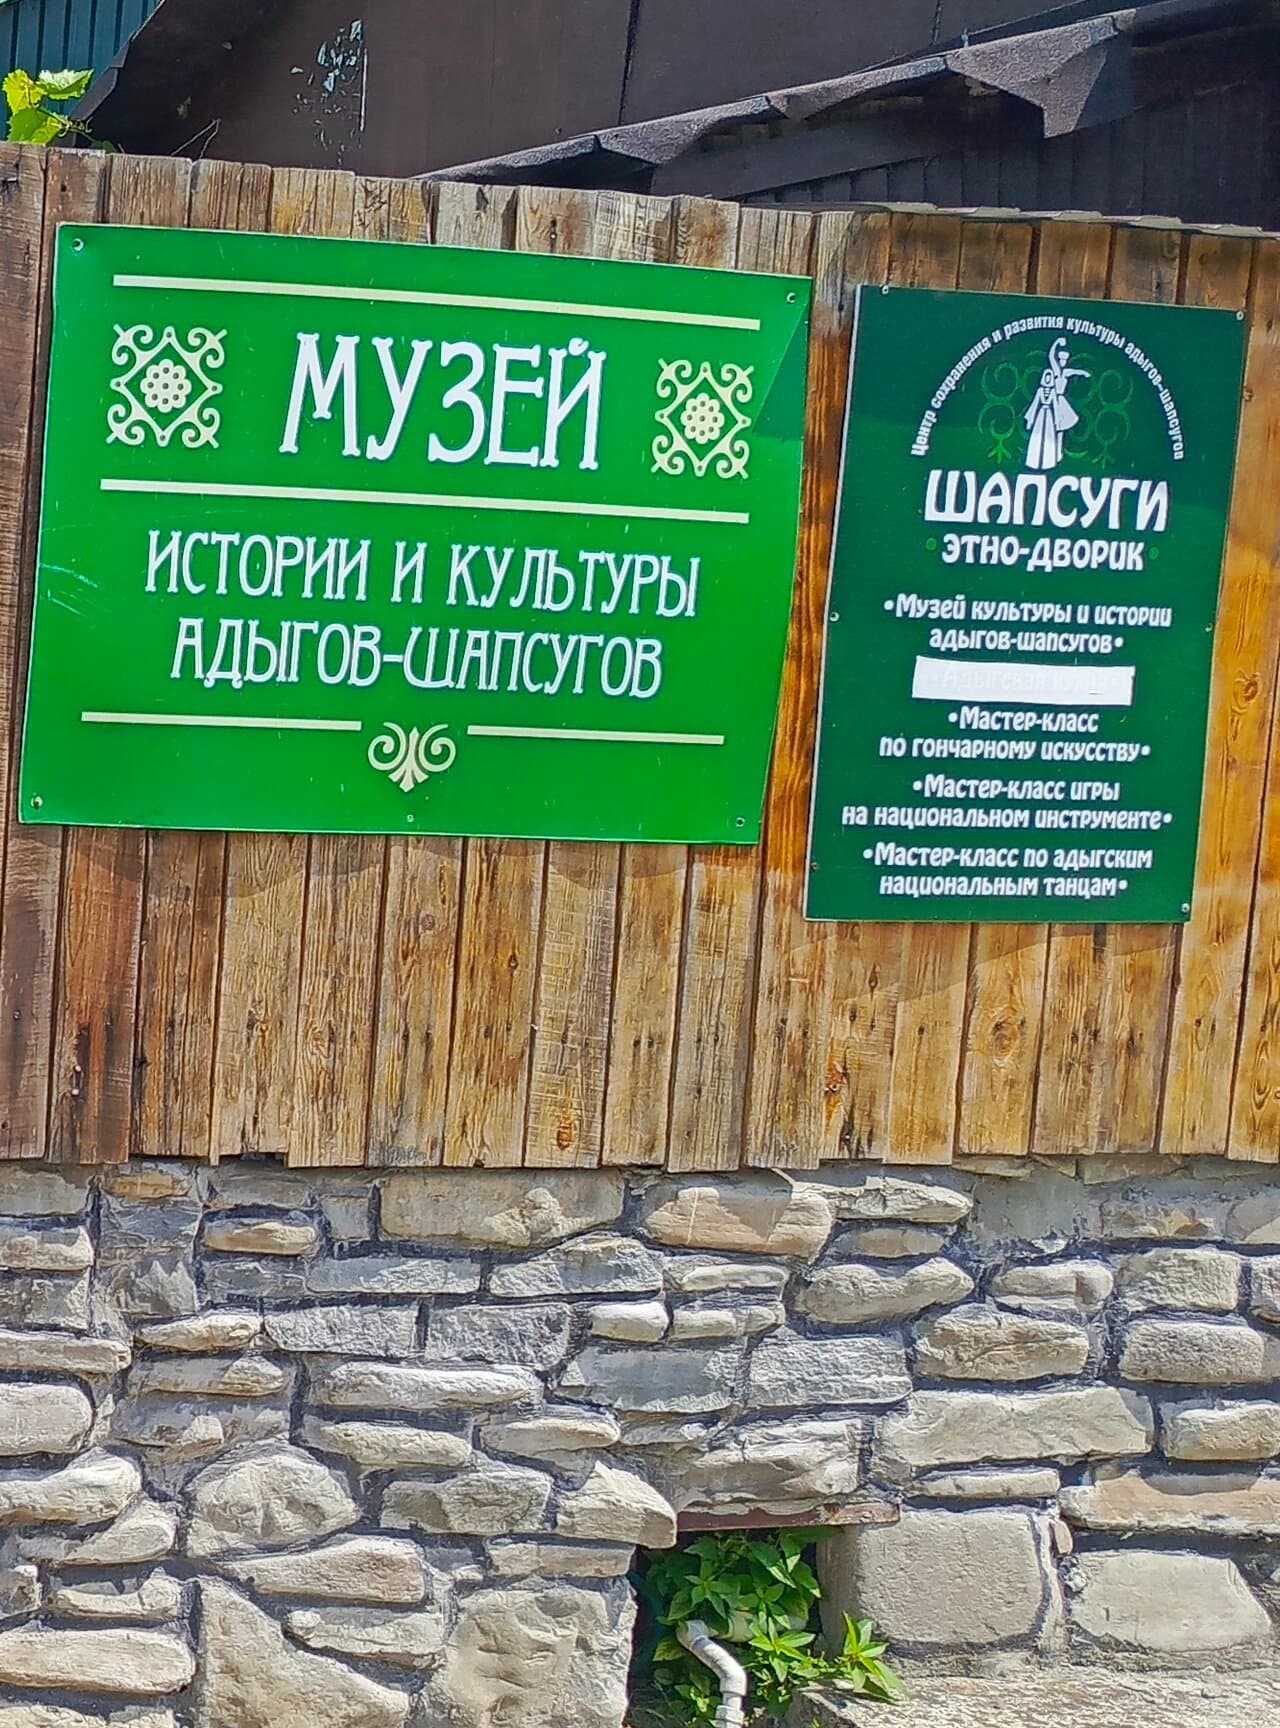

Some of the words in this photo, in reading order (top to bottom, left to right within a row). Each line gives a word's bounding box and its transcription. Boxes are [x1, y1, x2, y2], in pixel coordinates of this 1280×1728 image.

[280, 333, 606, 469] МУЗЕЙ
[912, 411, 936, 455] Центр
[932, 338, 991, 408] сохранения
[992, 330, 1001, 342] и
[1004, 316, 1065, 340] развития
[1067, 319, 1124, 347] культуры
[1125, 343, 1183, 459] адыгов-шапсугов
[925, 469, 1168, 531] ШАПСУГИ
[943, 534, 1144, 572] ЭТНО-ДВОРИК
[146, 531, 370, 600] ИСТОРИИ
[392, 542, 426, 602] И
[447, 545, 699, 616] КУЛЬТУРЫ
[896, 594, 965, 619] Музей
[972, 602, 1071, 622] культуры
[1077, 605, 1089, 623] и
[1095, 606, 1171, 626] истории
[171, 616, 662, 697] АДЫГОВ-ШАПСУГОВ
[960, 705, 1099, 732] Мастер-класс
[880, 737, 906, 756] по
[912, 739, 1036, 759] гончарному
[925, 774, 1065, 800] Мастер-класс
[1071, 782, 1119, 800] игры
[842, 806, 868, 826] на
[875, 807, 1029, 829] национальном
[875, 842, 1018, 867] Мастер-класс
[1024, 849, 1048, 867] по
[1054, 849, 1152, 870] адыгским
[880, 876, 1038, 897] национальным
